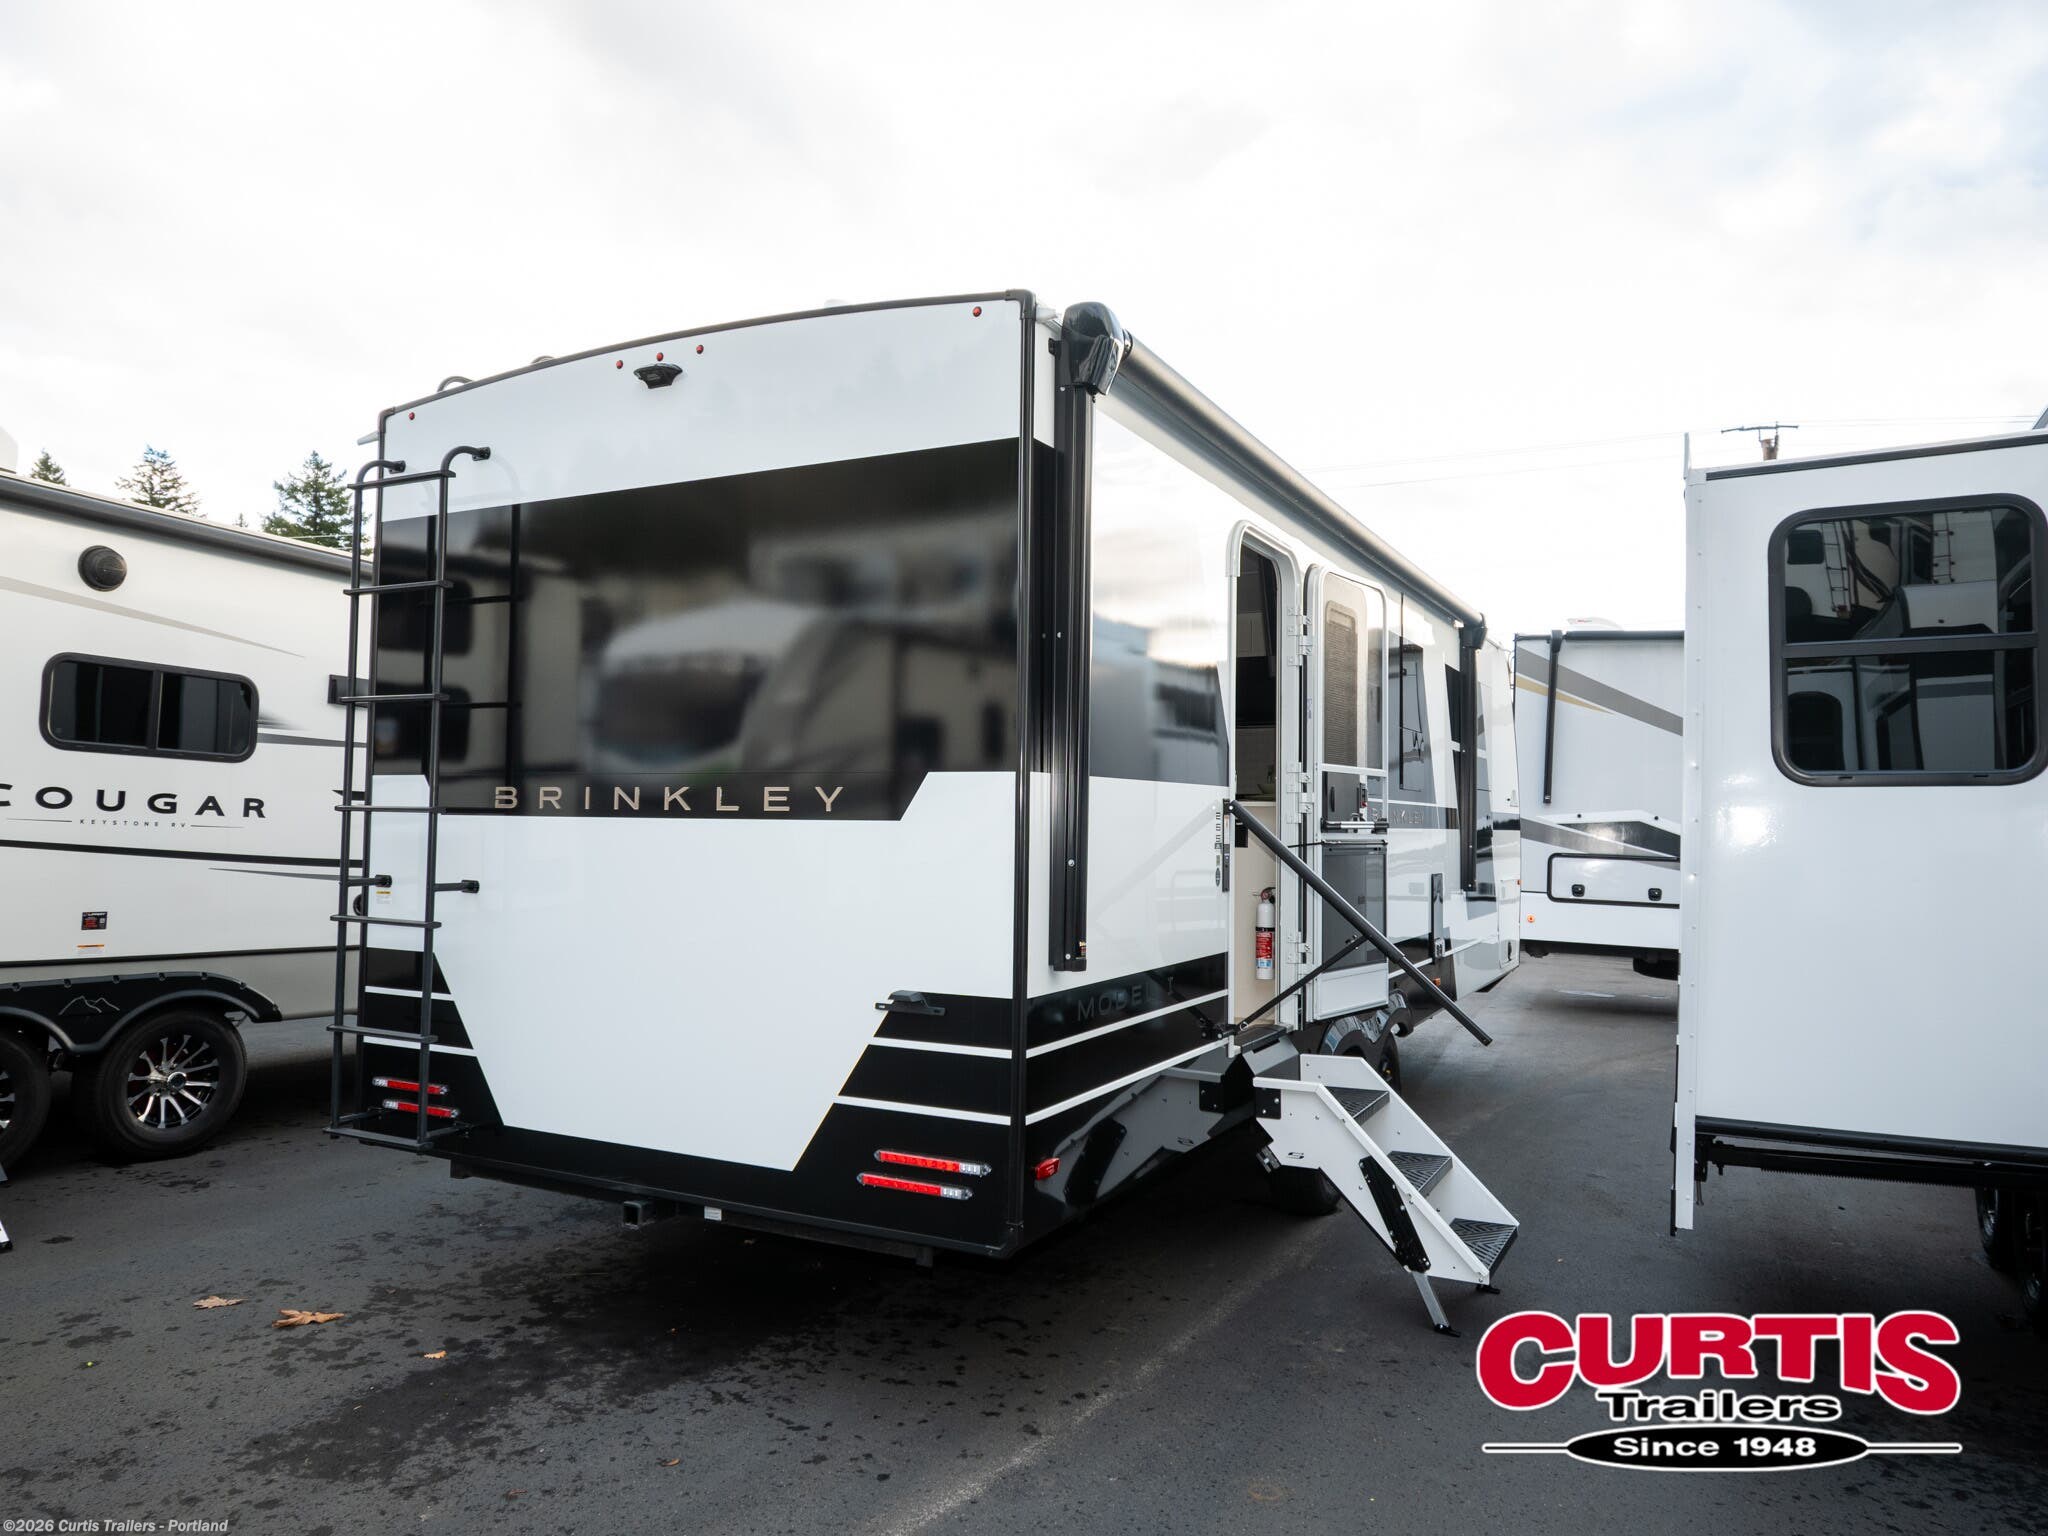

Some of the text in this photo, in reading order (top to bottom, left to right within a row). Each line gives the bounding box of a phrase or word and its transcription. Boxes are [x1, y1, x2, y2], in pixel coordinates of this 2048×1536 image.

[494, 786, 844, 812] BRINKLEY
[79, 819, 159, 828] KEYSTONE
[1077, 982, 1153, 1021] MODEL
